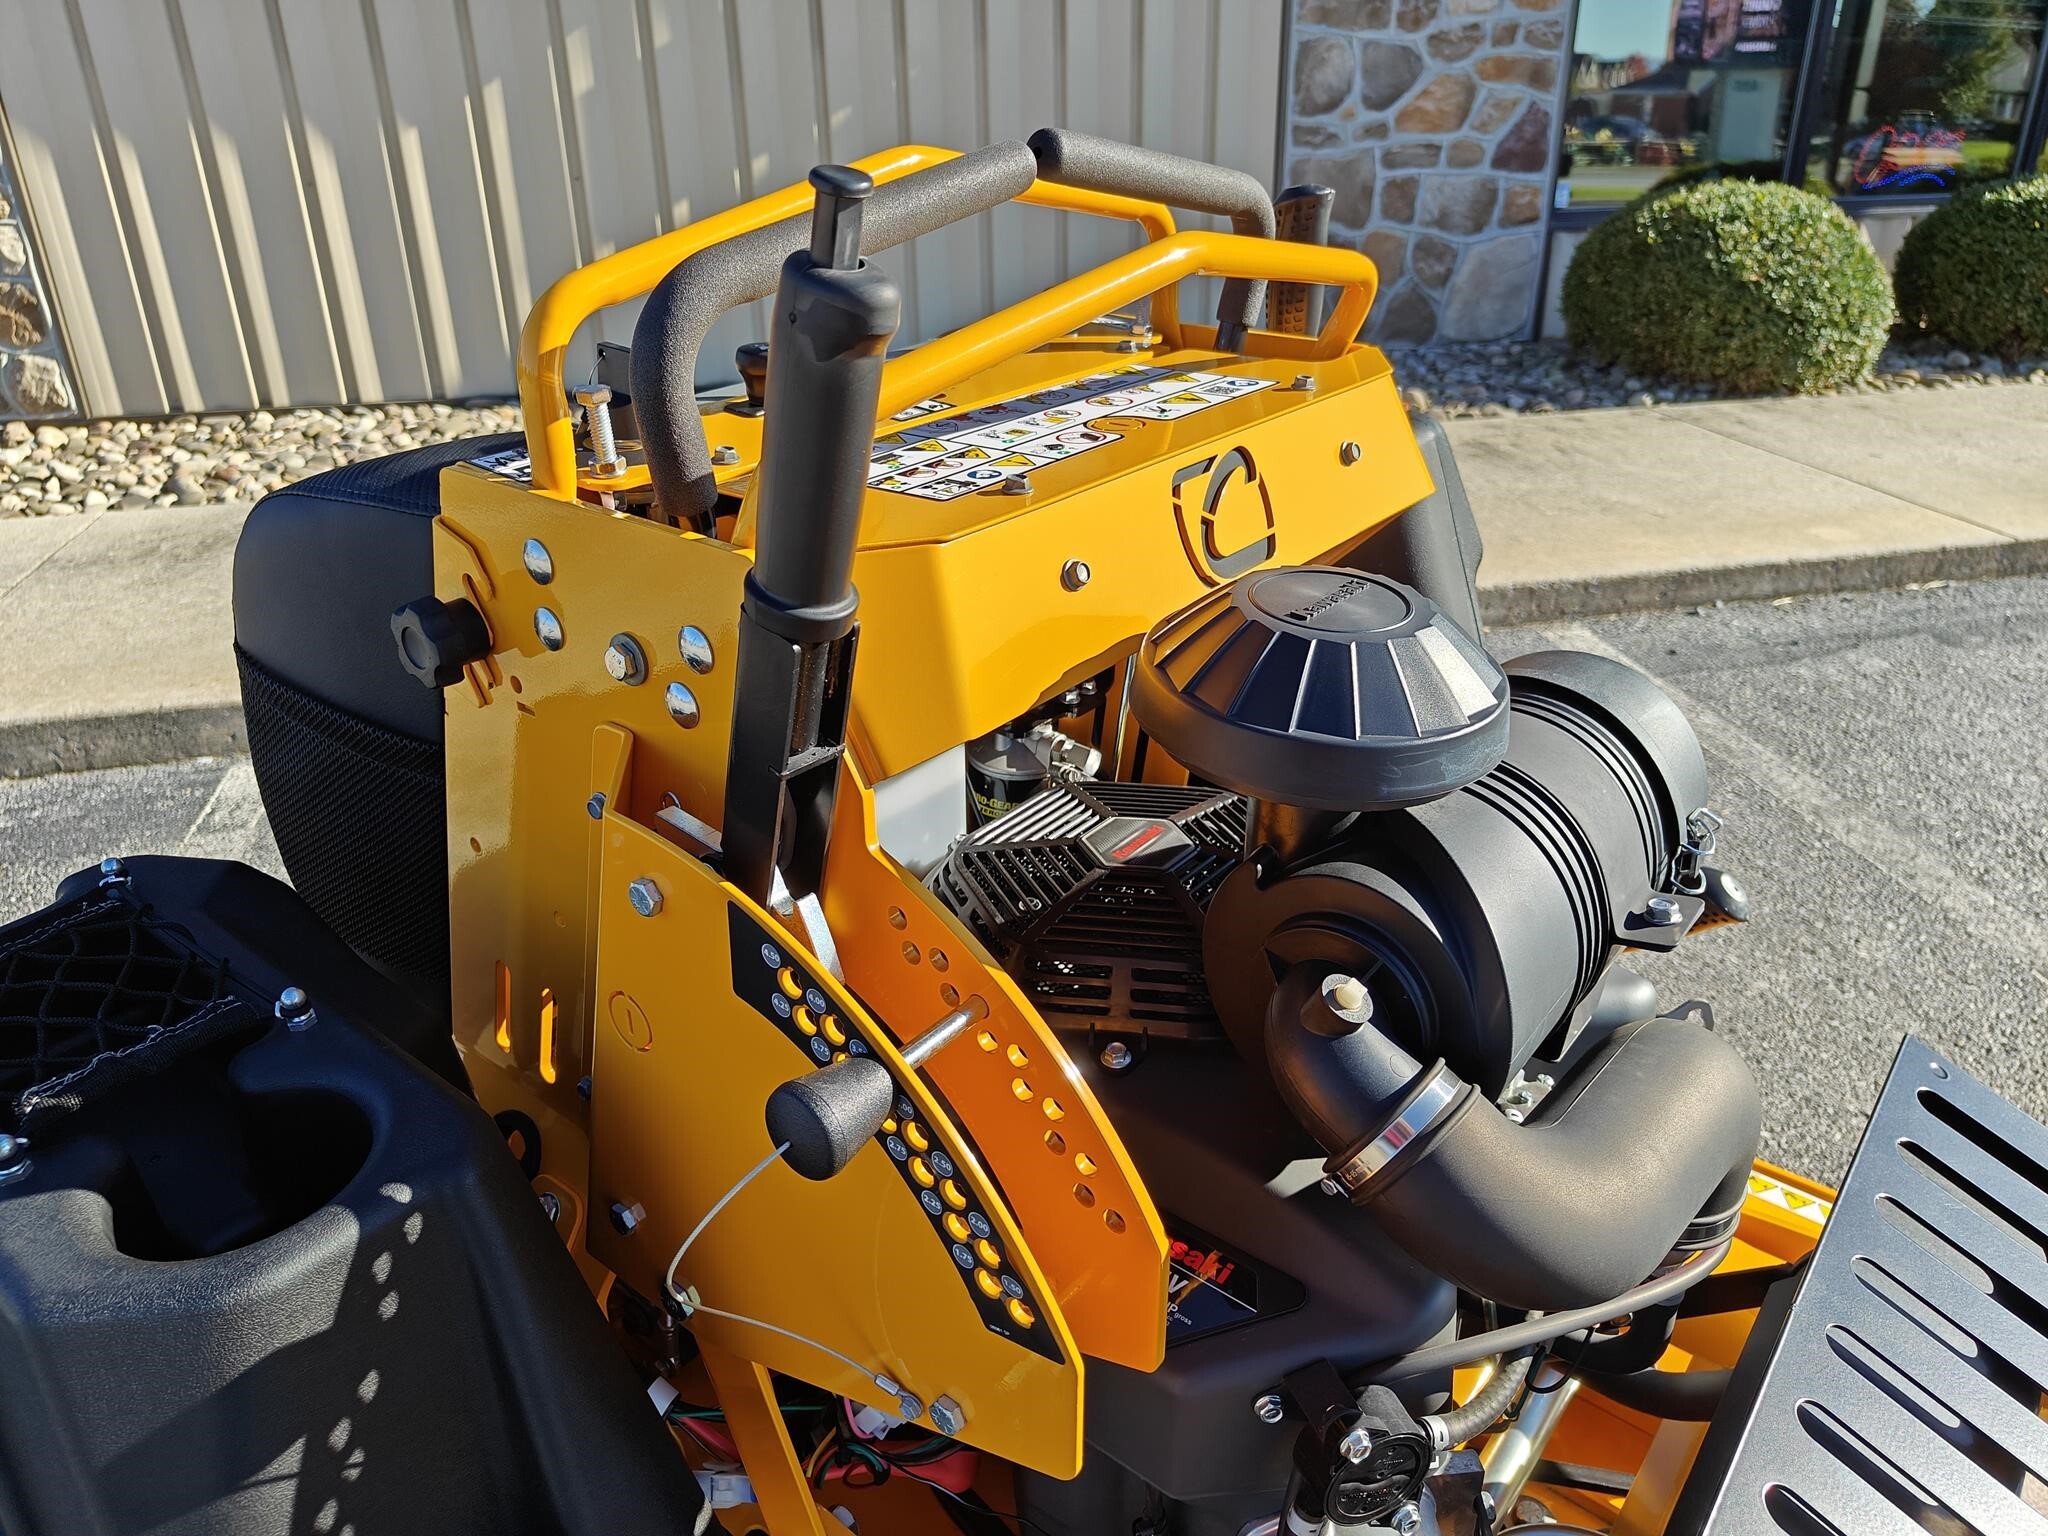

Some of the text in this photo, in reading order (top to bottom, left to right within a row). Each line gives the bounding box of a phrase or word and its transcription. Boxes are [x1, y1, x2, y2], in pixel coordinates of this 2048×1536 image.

[976, 793, 1018, 811] RO-GEAR
[764, 949, 780, 963] 4.50
[774, 998, 790, 1012] 4.25
[809, 995, 825, 1008] 4.00
[814, 1042, 829, 1056] 3.75
[889, 1139, 906, 1156] 2.75
[933, 1156, 951, 1171] 2.50
[924, 1195, 941, 1210] 2.25
[970, 1216, 988, 1232] 2.00
[955, 1248, 973, 1264] 1.75
[1004, 1280, 1022, 1295] 1.50
[1174, 1311, 1193, 1326] gross
